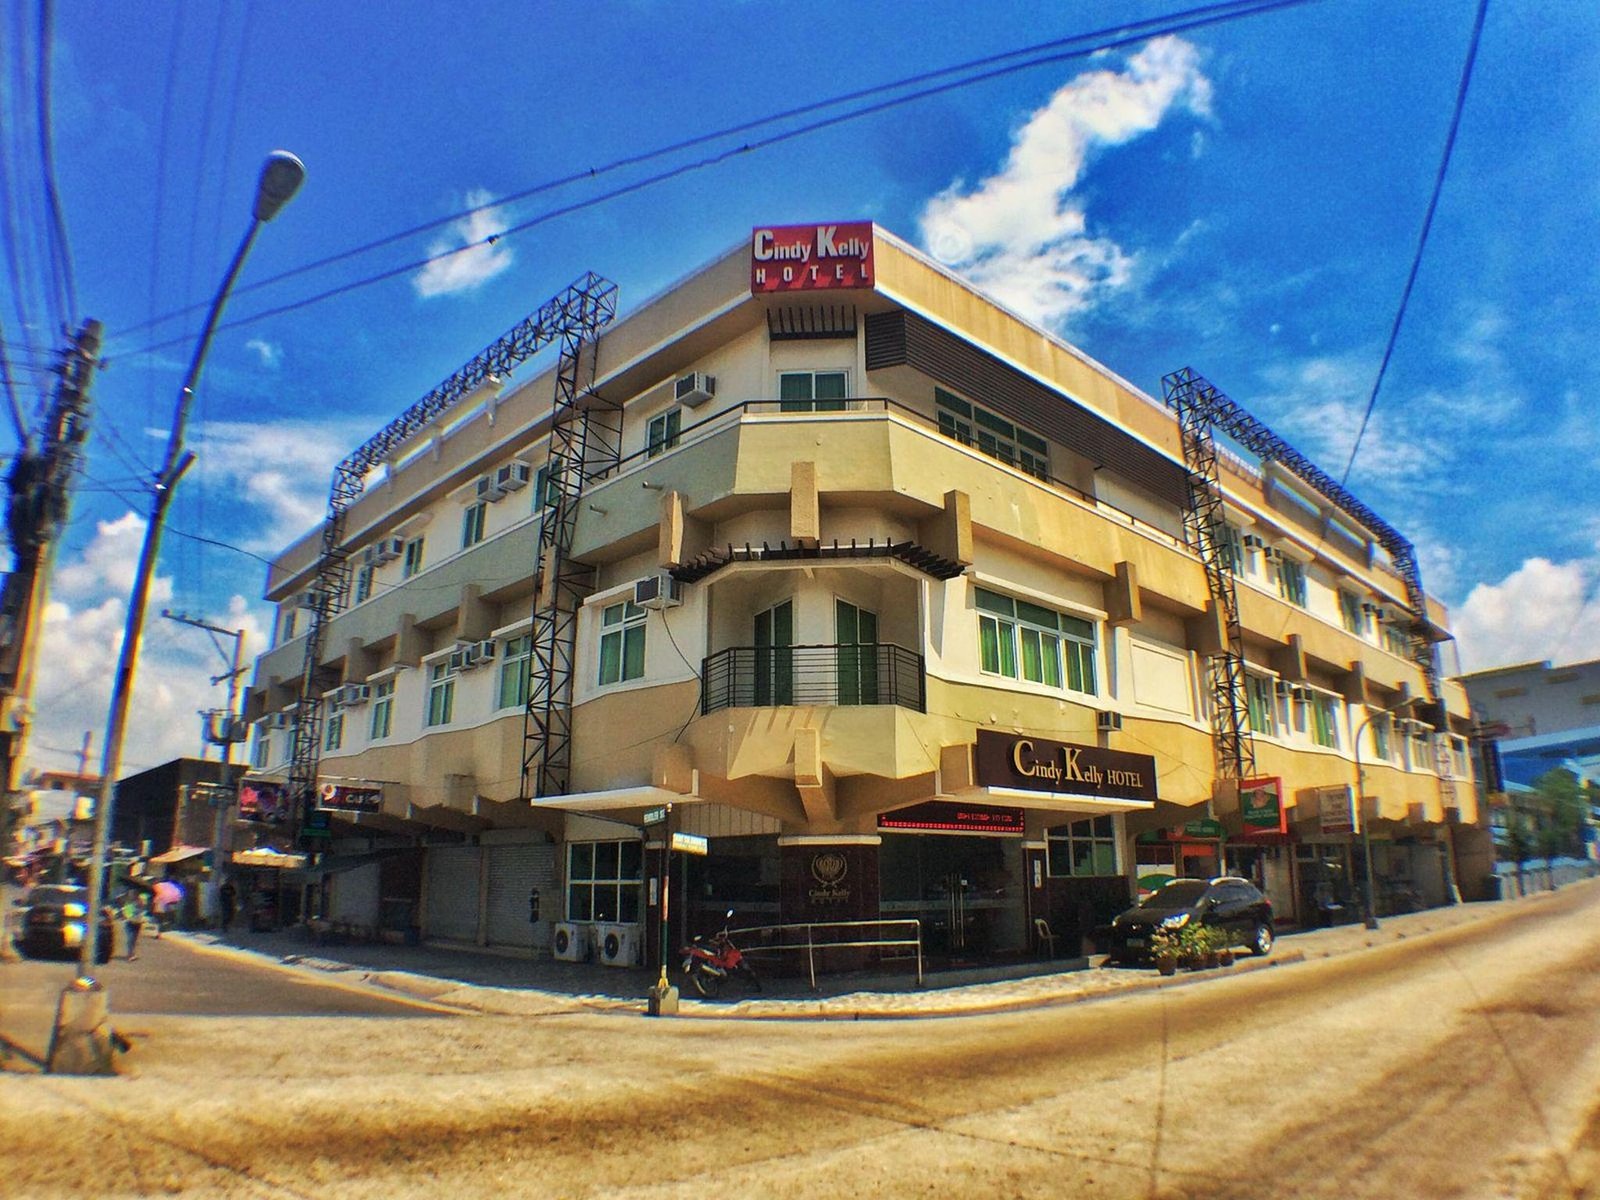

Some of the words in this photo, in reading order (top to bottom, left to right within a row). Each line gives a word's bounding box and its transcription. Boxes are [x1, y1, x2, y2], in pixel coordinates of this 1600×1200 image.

[754, 229, 811, 263] Cindy
[817, 225, 870, 260] Kelly
[756, 264, 867, 283] HOTEL
[1014, 740, 1062, 784] Cindy
[1063, 746, 1103, 788] Kelly
[1107, 769, 1143, 787] HOTEL
